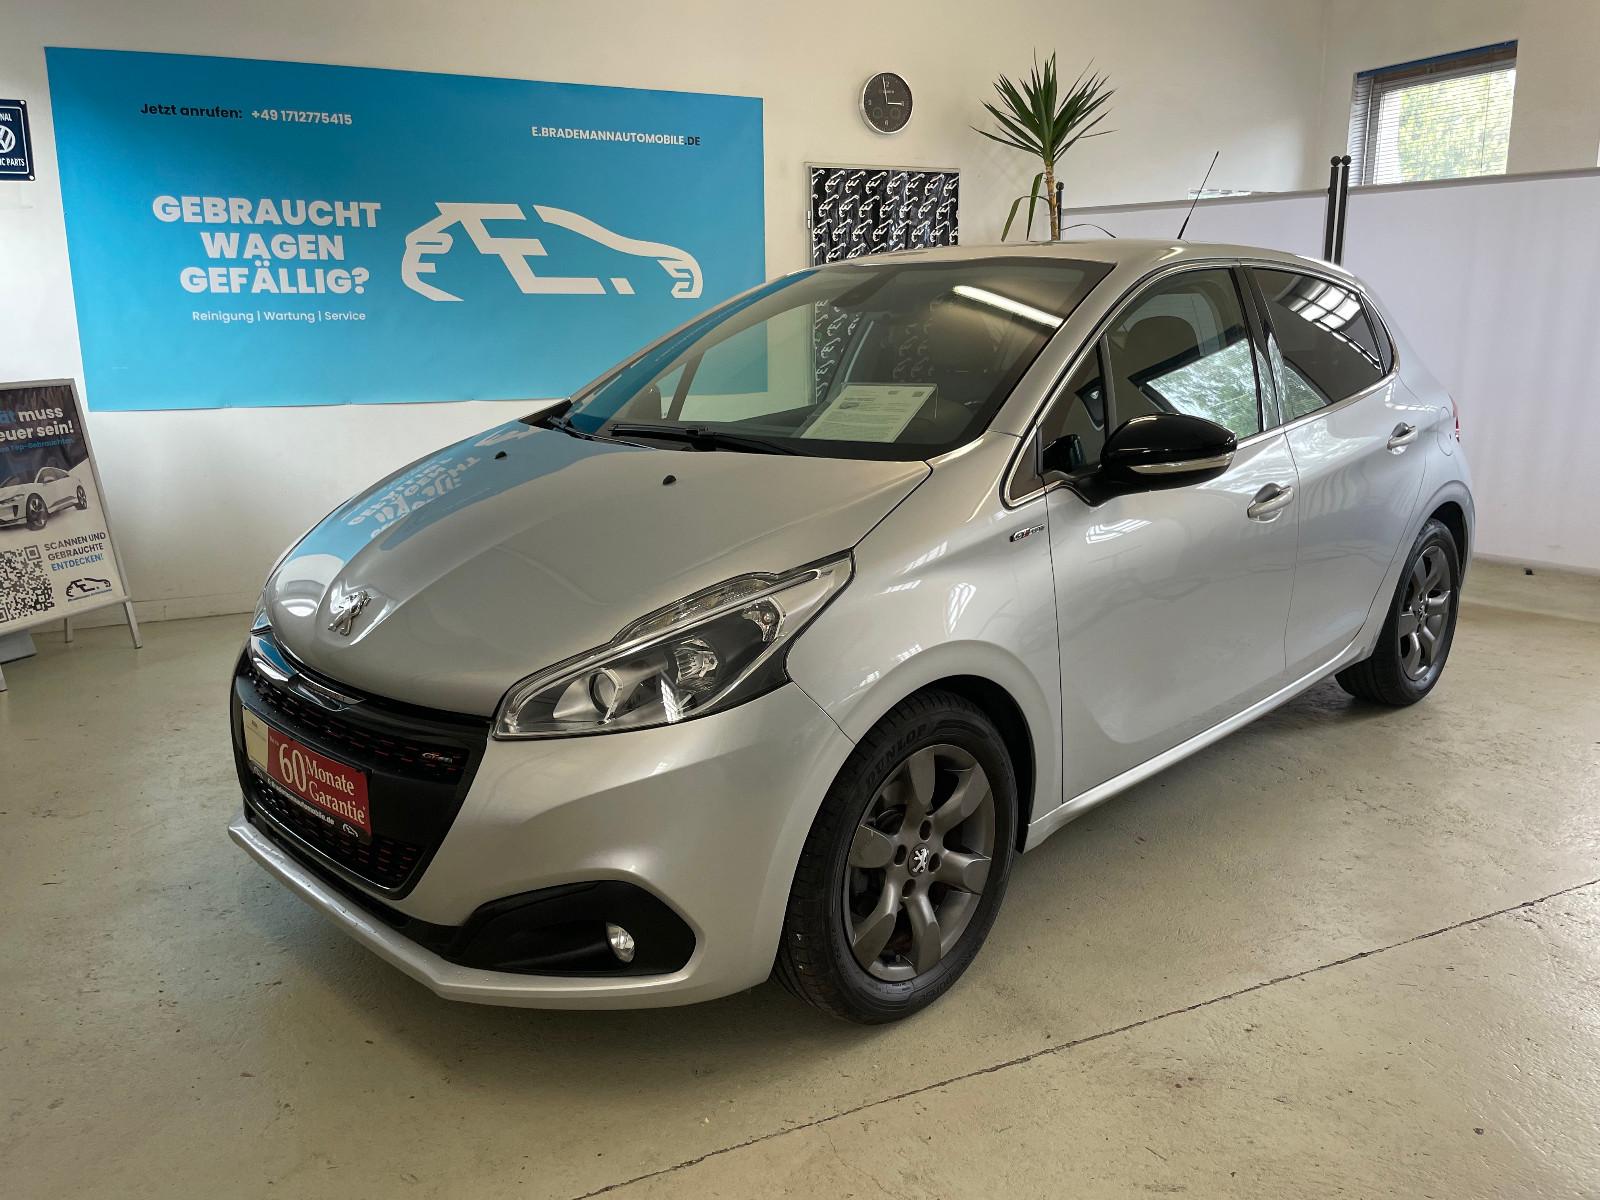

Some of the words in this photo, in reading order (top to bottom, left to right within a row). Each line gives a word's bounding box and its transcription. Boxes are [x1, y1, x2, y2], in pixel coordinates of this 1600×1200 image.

[140, 103, 177, 116] Jetzt
[180, 105, 243, 119] anrufen:
[251, 109, 278, 121] +49
[281, 110, 353, 125] 1712775415
[531, 126, 701, 146] E.BRADEMANNAUTOMOBILE.DE
[6, 158, 25, 166] PARTS
[152, 195, 381, 228] GEBRAUCHT
[200, 232, 345, 261] WAGEN
[180, 260, 370, 294] GEFÄLLIG?
[192, 311, 254, 323] Reinigung
[263, 311, 315, 323] Wartung
[324, 311, 366, 321] Service
[18, 407, 63, 422] muss
[37, 420, 74, 437] sein!
[44, 535, 88, 551] SCANNEN
[88, 532, 106, 542] UND
[48, 543, 104, 561] GEBRAUCHTE
[51, 553, 104, 571] ENTDECKEN!
[279, 743, 306, 793] 60
[305, 755, 355, 796] Monate
